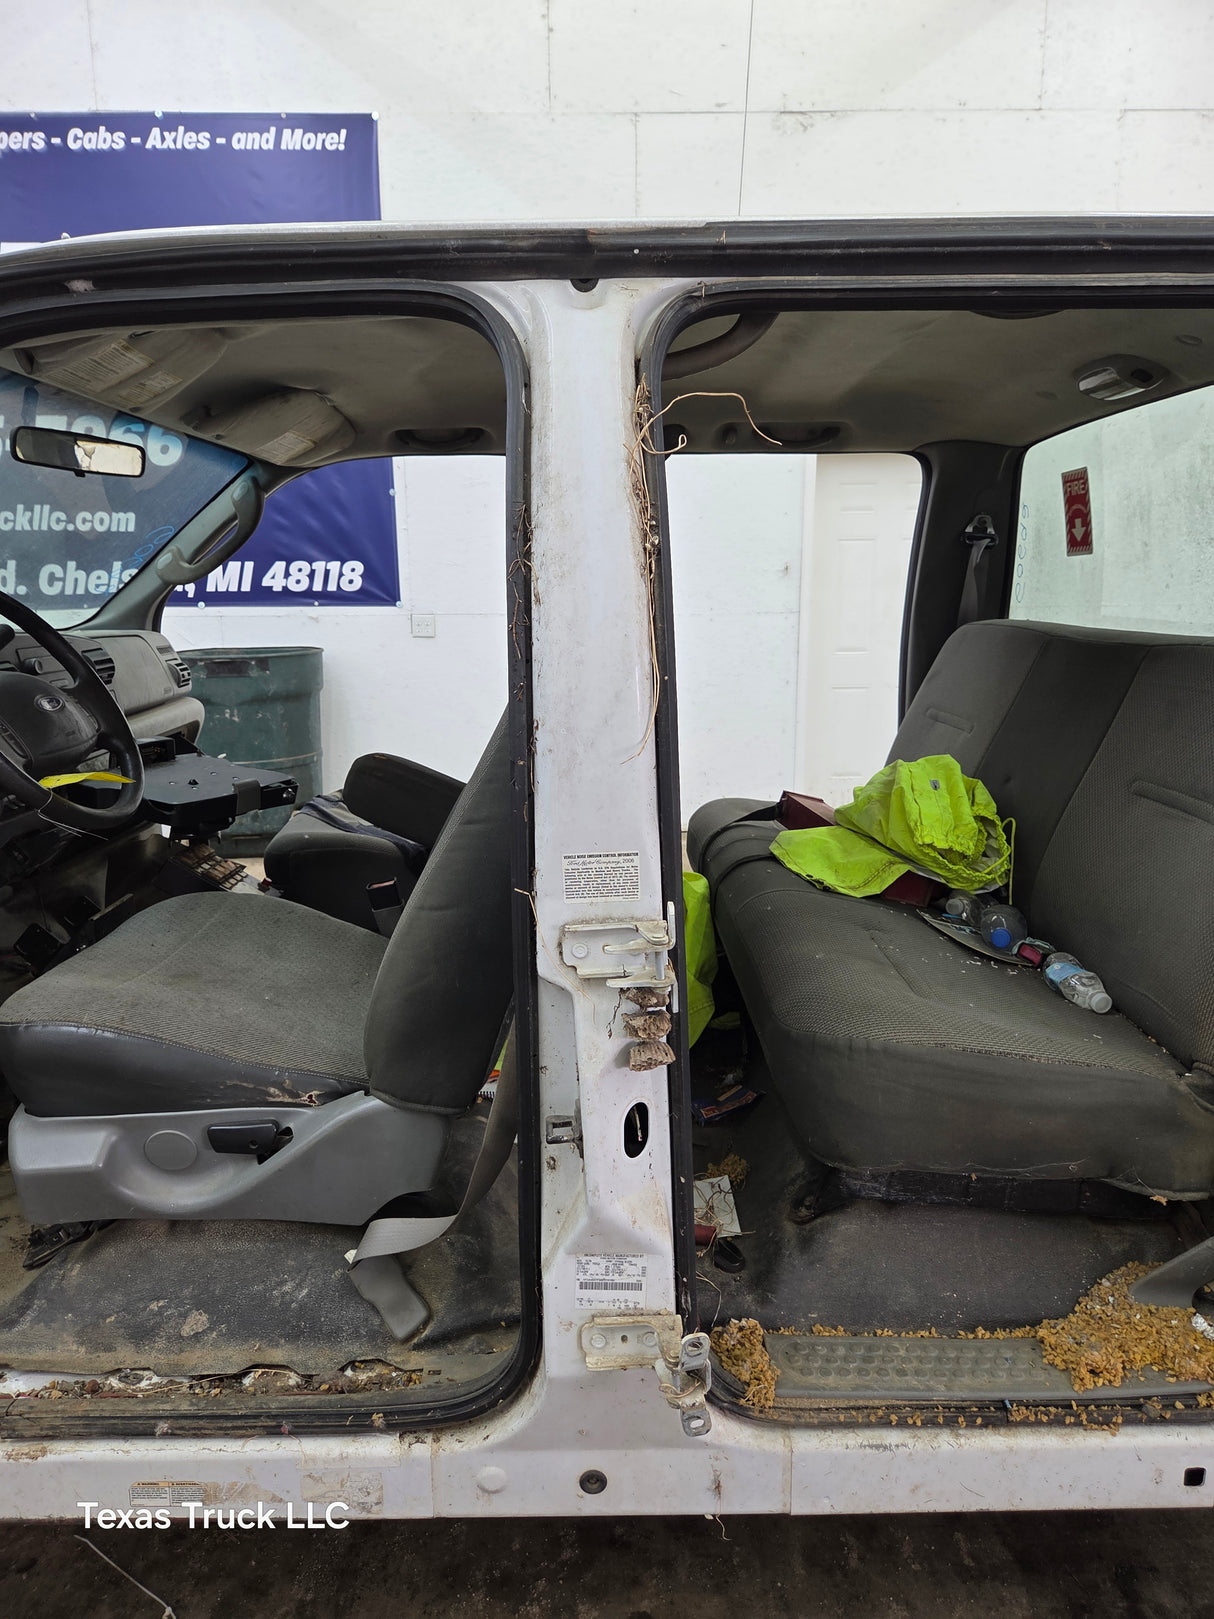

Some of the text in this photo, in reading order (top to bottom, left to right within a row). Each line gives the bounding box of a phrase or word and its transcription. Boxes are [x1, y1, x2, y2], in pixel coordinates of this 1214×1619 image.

[67, 125, 126, 150] Cabs
[145, 125, 210, 150] Axles
[232, 126, 276, 150] and
[280, 128, 347, 151] More!
[1066, 480, 1087, 496] FIRE
[206, 561, 255, 592] MI
[261, 560, 365, 593] 48118
